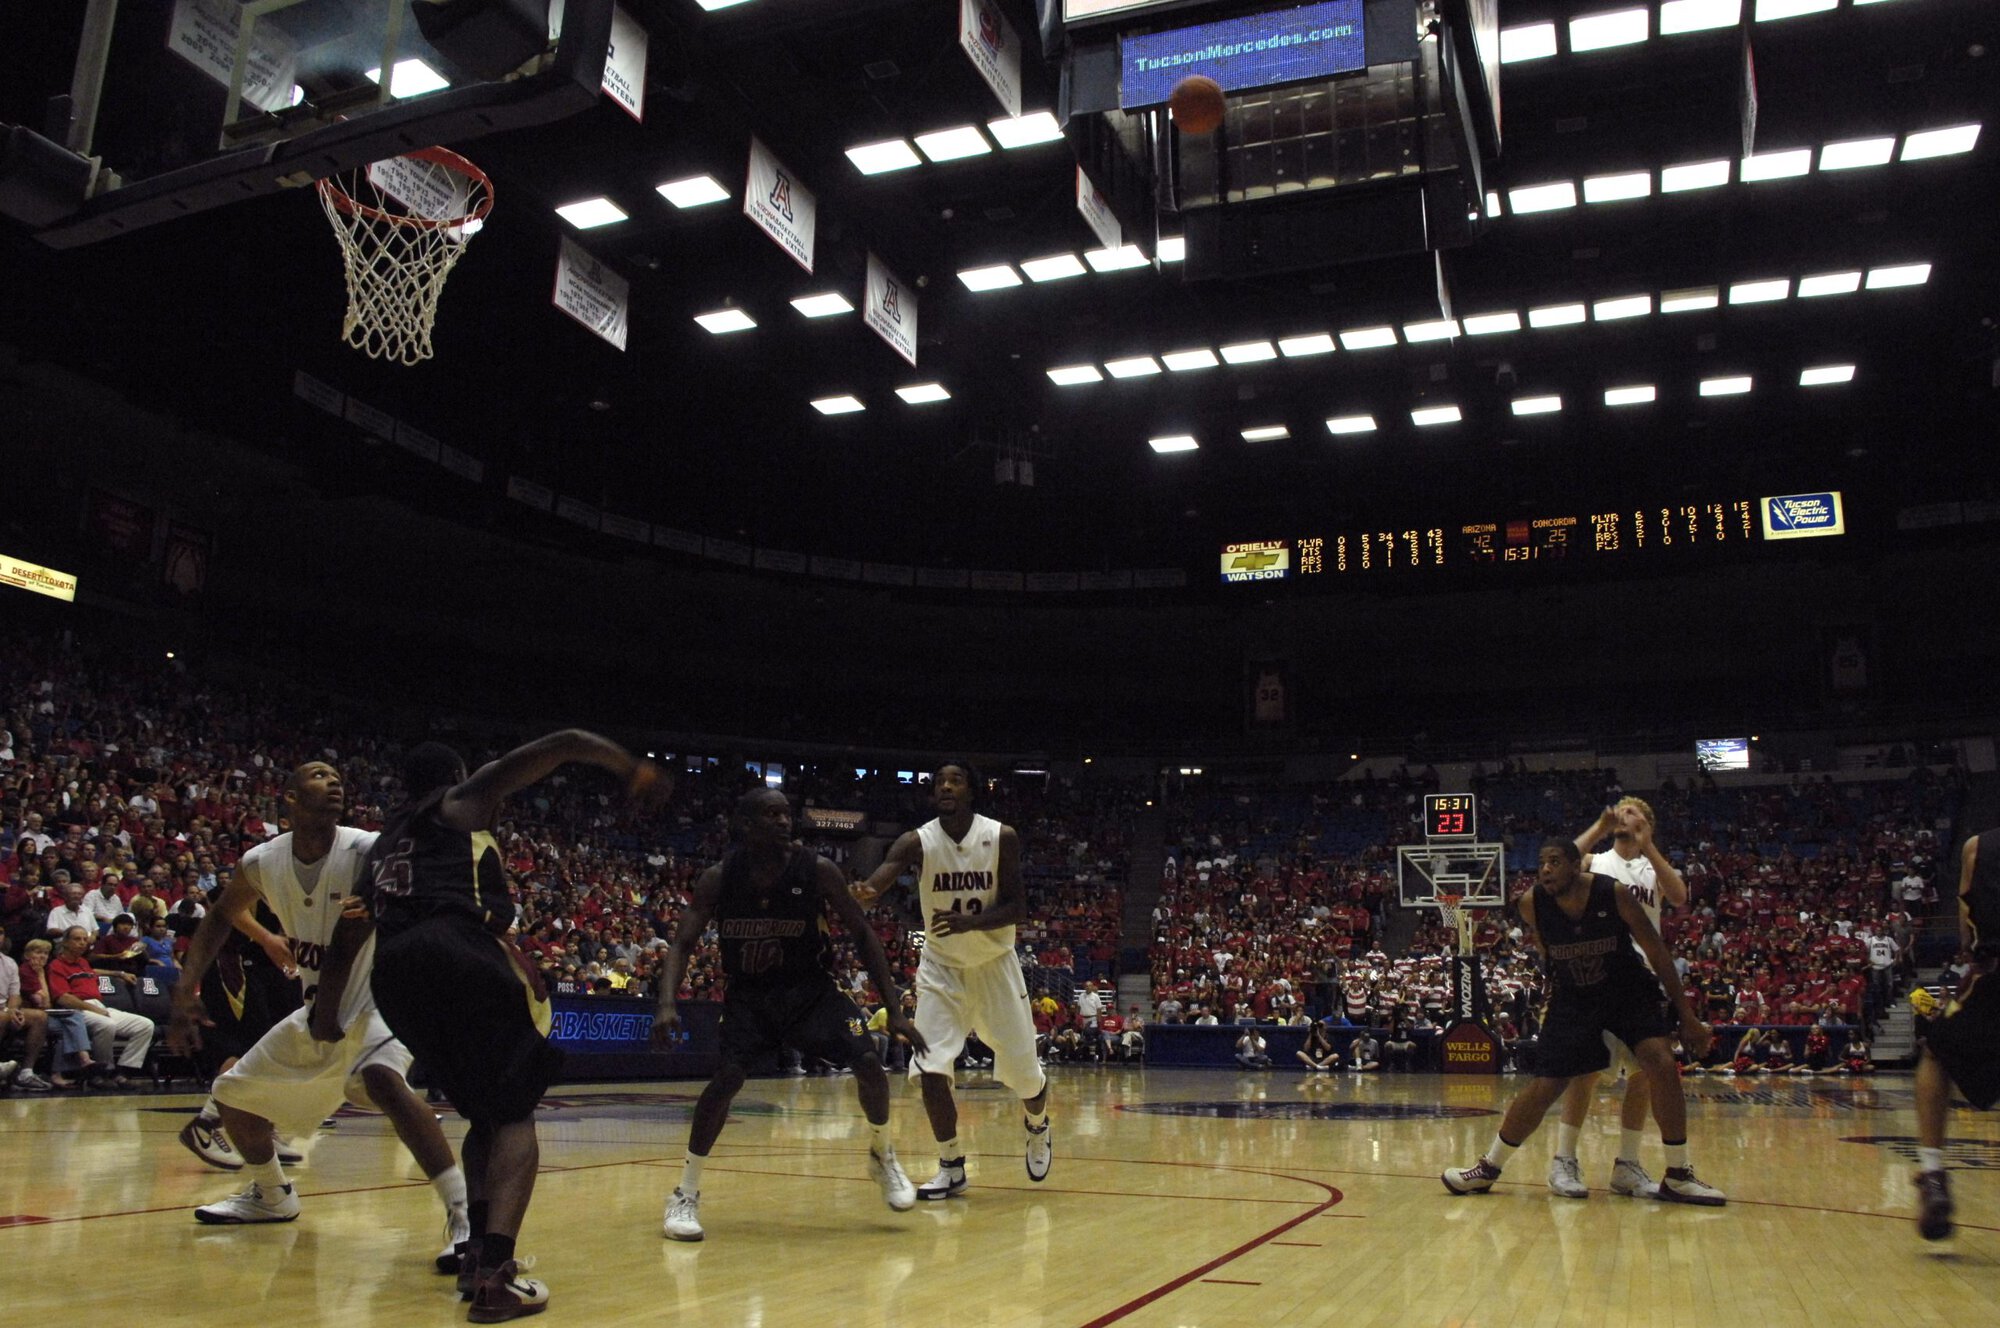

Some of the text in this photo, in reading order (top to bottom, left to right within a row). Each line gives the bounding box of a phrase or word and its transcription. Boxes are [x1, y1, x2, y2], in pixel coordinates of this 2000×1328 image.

[1135, 25, 1350, 71] TucsonMercedes.com
[1784, 500, 1820, 509] Tucson
[1789, 506, 1828, 516] Electric
[1591, 513, 1619, 524] PLYR
[1635, 511, 1643, 520] 6
[1680, 506, 1696, 516] 10
[1707, 504, 1722, 514] 12
[1734, 501, 1749, 511] 15
[1794, 515, 1829, 524] Power
[1462, 523, 1496, 534] ARIZONA
[1532, 517, 1576, 528] CONCORDIA
[1597, 522, 1616, 532] PTS
[1688, 515, 1696, 524] 7
[1742, 511, 1750, 520] 4
[1298, 529, 1442, 548] PLYR 0 5 34 42 43
[1549, 529, 1566, 542] 25
[1596, 520, 1751, 542] RBS 2 1 5 4 2
[1227, 541, 1282, 552] O'RIELLY
[1474, 535, 1491, 548] 42
[1596, 540, 1619, 551] FLS
[1638, 539, 1642, 547] 1
[1663, 536, 1671, 545] 0
[1716, 532, 1725, 541] 0
[1745, 529, 1749, 538] 1
[1302, 547, 1320, 556] PTS
[1338, 545, 1345, 553] 8
[1411, 540, 1418, 548] 2
[1505, 546, 1538, 561] 15:31
[1301, 556, 1321, 565] RBS
[1338, 554, 1346, 562] 2
[1362, 552, 1369, 560] 2
[1411, 548, 1418, 557] 3
[1436, 547, 1443, 555] 4
[1339, 562, 1346, 571] 0
[1363, 560, 1370, 569] 0
[1411, 557, 1418, 566] 0
[1436, 555, 1443, 564] 2
[12, 567, 42, 580] DESERT
[45, 576, 74, 590] TOYOTA
[1227, 570, 1283, 581] WATSON
[1260, 689, 1278, 701] 32
[1435, 798, 1468, 810] 15:31
[1438, 814, 1464, 832] 23
[932, 871, 993, 892] ARIZONA
[722, 918, 806, 939] CONCORDIA
[557, 982, 576, 993] POSS.
[1461, 961, 1472, 1018] ARIZONA
[549, 1011, 656, 1040] ABASKETB
[1446, 1042, 1491, 1051] WELLS
[1448, 1053, 1490, 1061] FARGO
